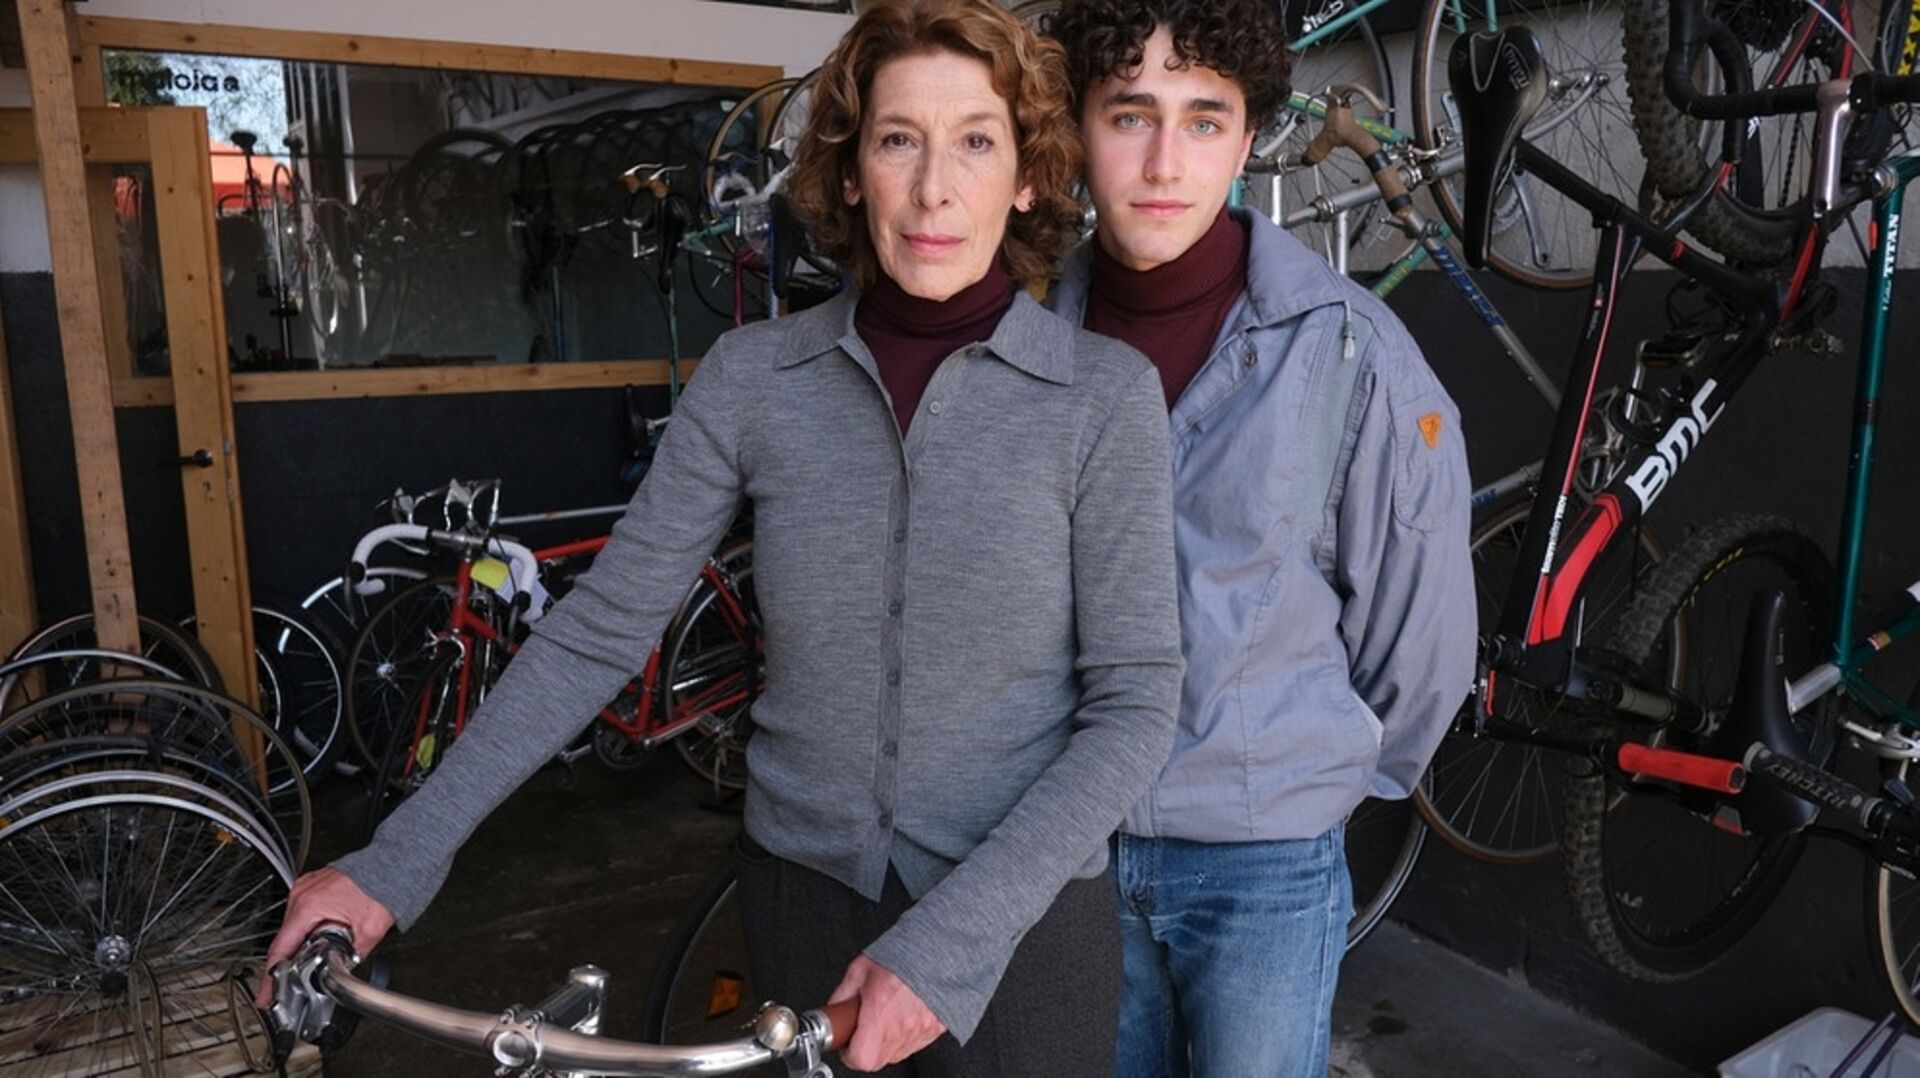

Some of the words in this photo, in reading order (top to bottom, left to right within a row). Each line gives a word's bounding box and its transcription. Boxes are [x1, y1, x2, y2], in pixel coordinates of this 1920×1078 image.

[1883, 213, 1899, 278] TITAN
[1624, 378, 1726, 516] BMC
[1764, 763, 1847, 809] RITCHEY
